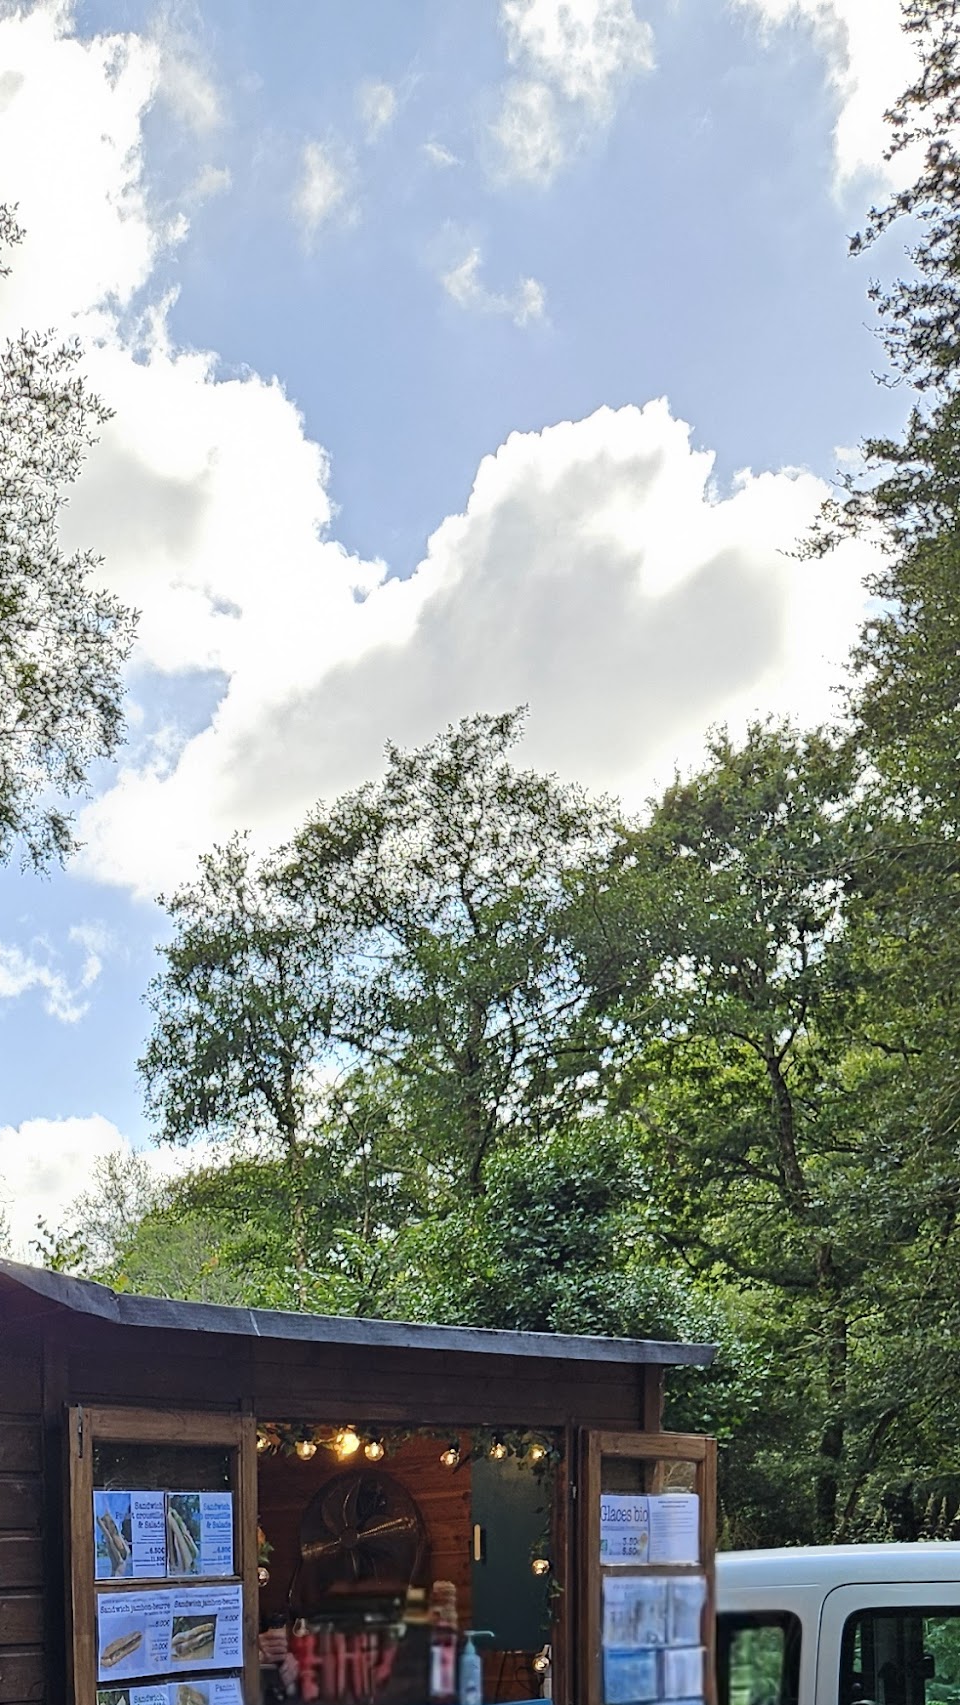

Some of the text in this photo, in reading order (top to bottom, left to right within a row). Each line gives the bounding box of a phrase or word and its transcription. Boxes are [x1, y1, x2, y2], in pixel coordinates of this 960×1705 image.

[134, 1501, 164, 1510] Sandwich
[203, 1502, 231, 1510] Sandwich
[601, 1504, 648, 1521] Glaces bio
[144, 1520, 165, 1528] Salade
[100, 1604, 130, 1613] Sandwich
[174, 1600, 202, 1608] Sandwich
[134, 1695, 165, 1704] Sandwich
